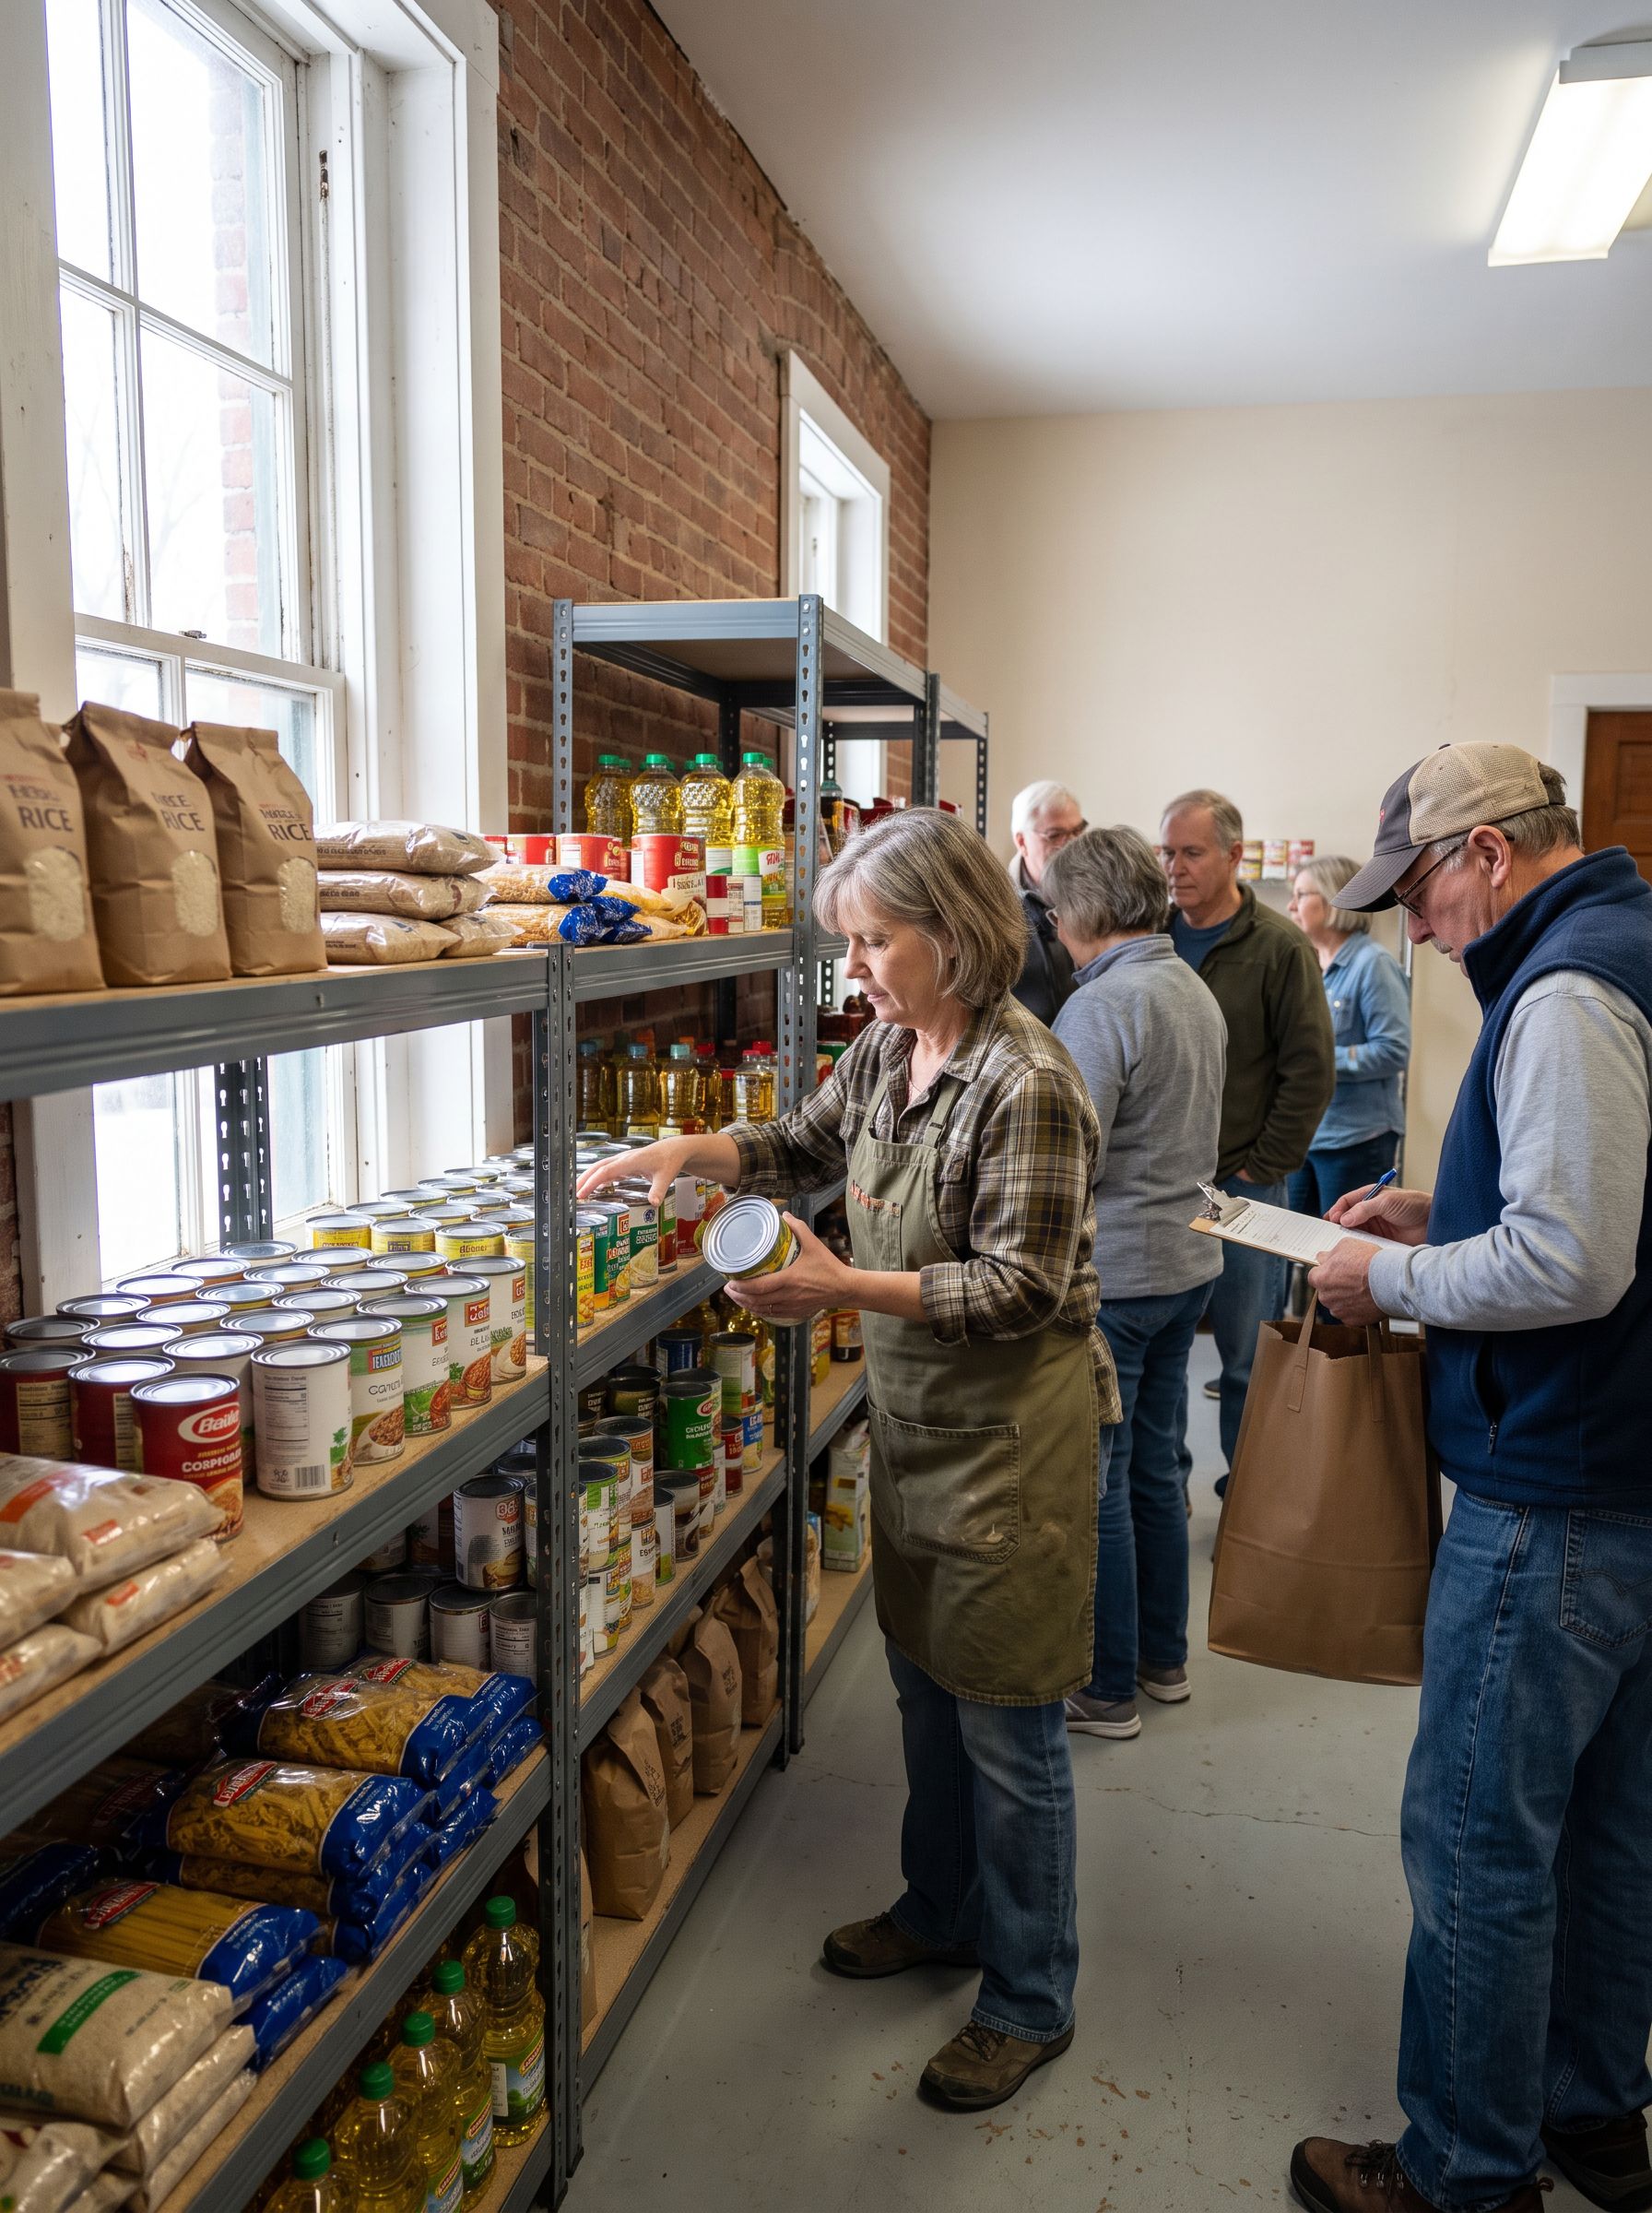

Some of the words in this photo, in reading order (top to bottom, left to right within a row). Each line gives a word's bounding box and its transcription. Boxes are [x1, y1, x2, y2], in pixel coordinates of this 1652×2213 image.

[18, 806, 73, 832] RICE
[160, 810, 206, 832] RICE
[266, 822, 313, 841] RICE
